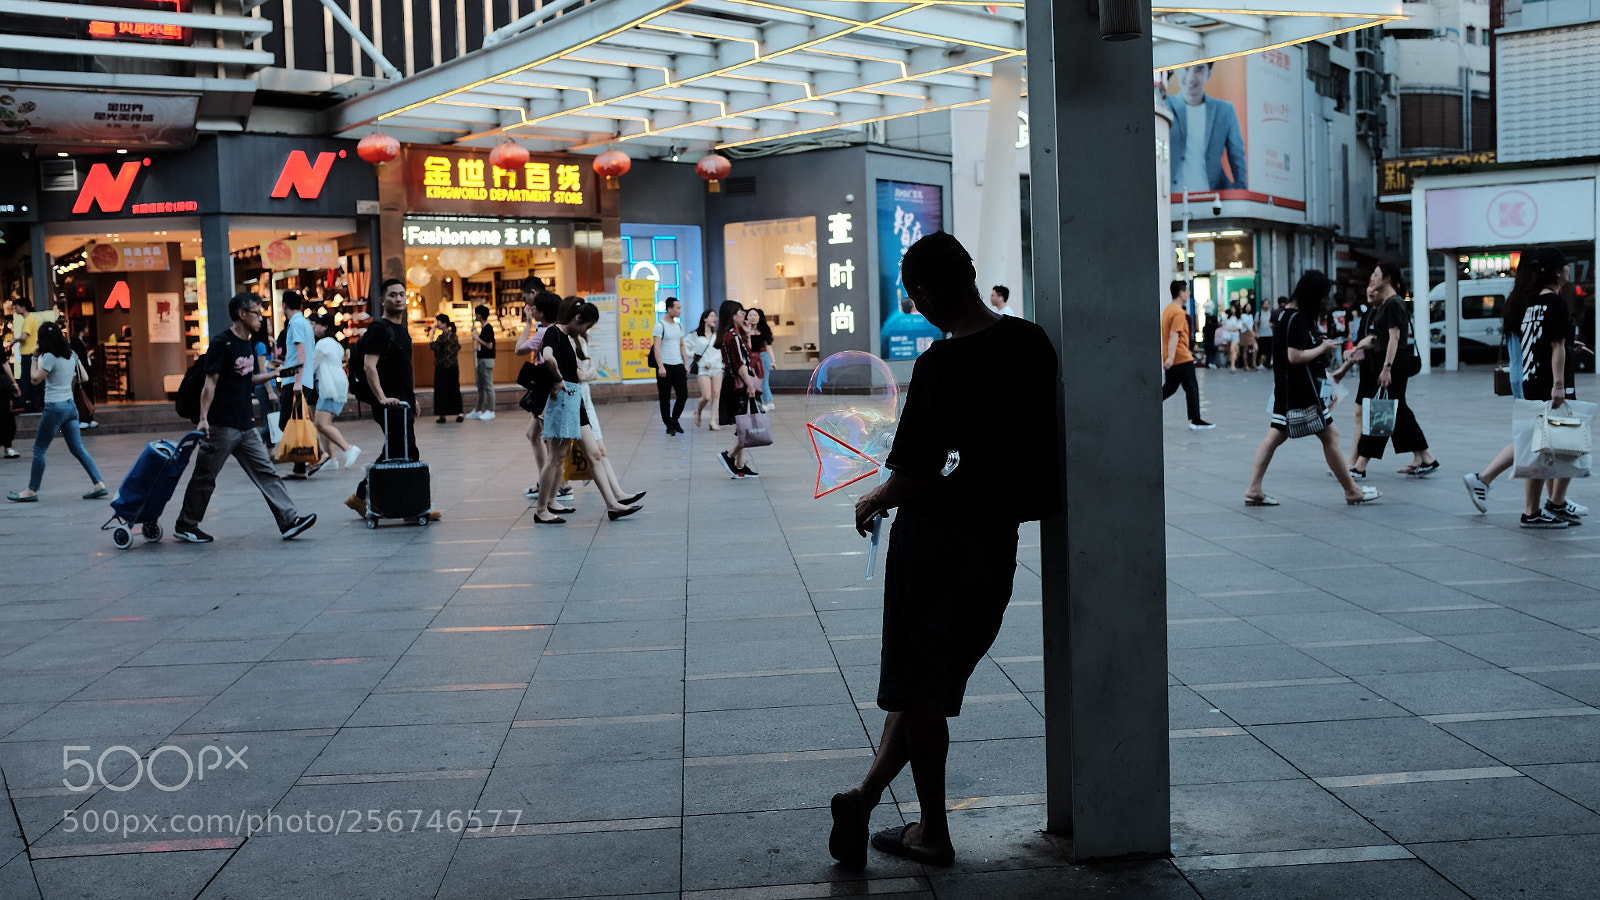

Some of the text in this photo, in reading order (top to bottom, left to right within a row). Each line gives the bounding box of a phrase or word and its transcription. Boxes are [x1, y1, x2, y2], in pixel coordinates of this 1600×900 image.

[426, 185, 584, 205] KINGWORLD DEPARTMENT STORE
[407, 226, 501, 245] Fashionone
